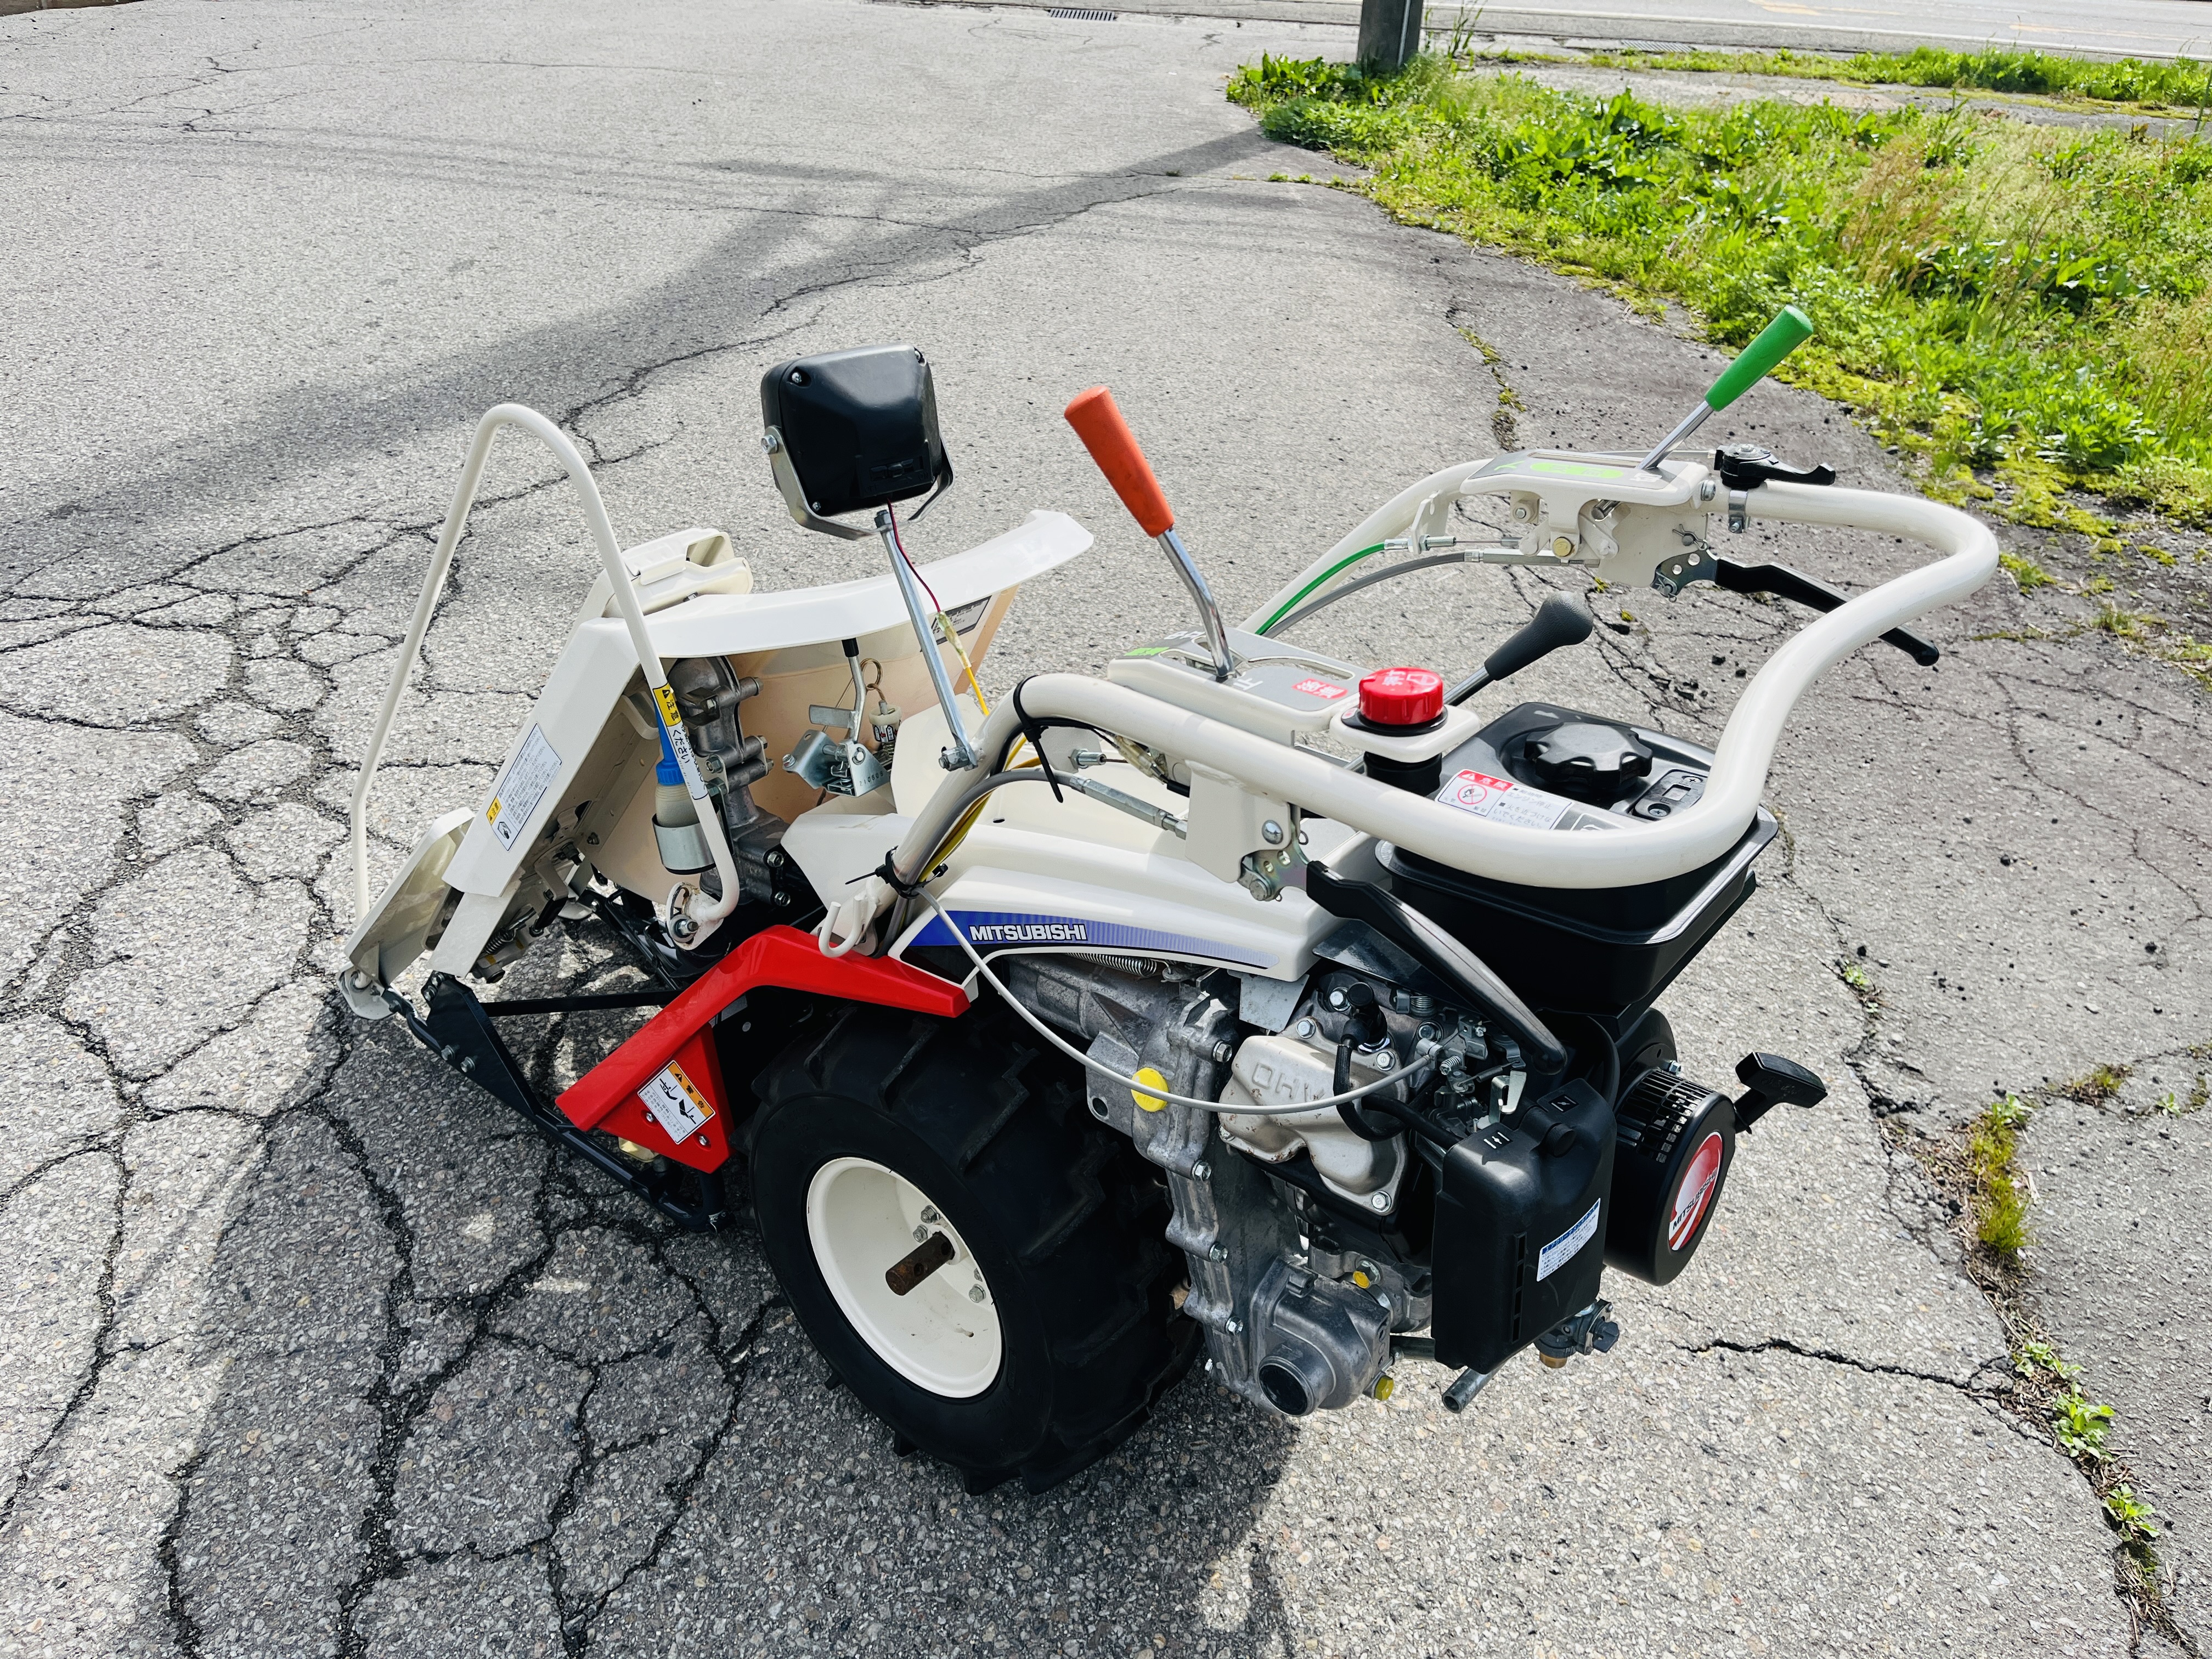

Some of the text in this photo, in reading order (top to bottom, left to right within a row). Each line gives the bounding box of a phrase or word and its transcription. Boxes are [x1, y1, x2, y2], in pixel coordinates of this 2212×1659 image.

[666, 698, 680, 721] 注意
[673, 729, 690, 764] ください
[1479, 777, 1509, 789] 危険
[1507, 793, 1553, 810] エンジン停止
[968, 923, 1088, 942] MITSUBISHI
[1252, 1062, 1325, 1103] OHV
[686, 1085, 705, 1109] 警告
[1673, 1167, 1718, 1231] MITSUBISHI
